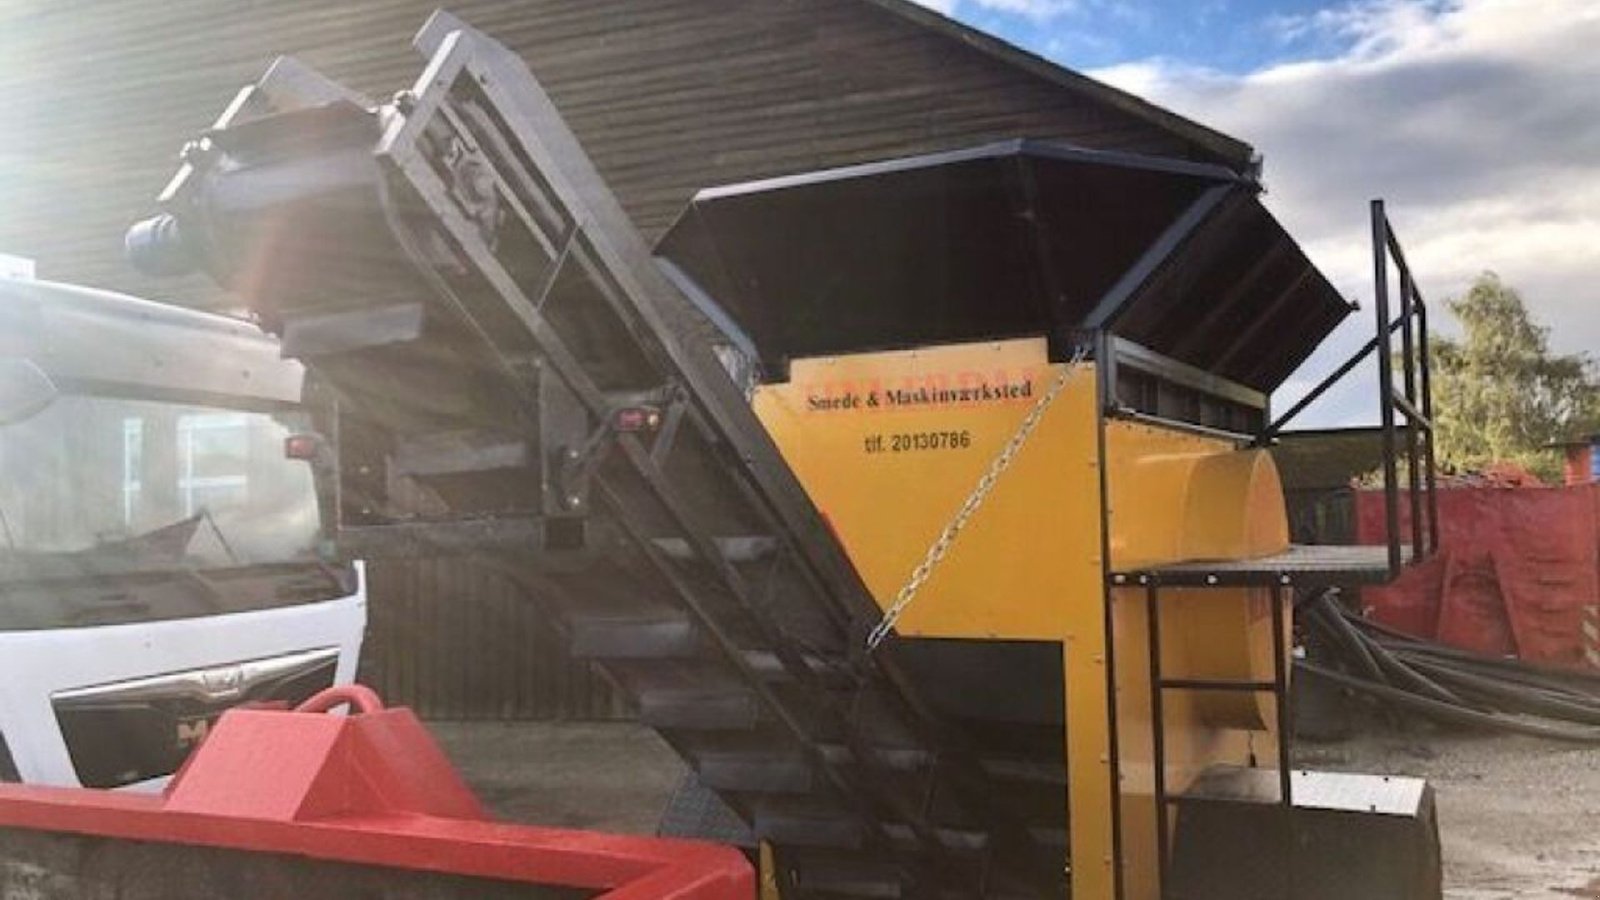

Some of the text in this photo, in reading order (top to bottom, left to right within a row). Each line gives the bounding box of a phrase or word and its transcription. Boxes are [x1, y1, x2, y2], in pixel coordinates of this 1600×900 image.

[807, 391, 860, 412] Smede
[866, 390, 879, 409] &
[886, 379, 1032, 405] Maskinværksted
[892, 430, 971, 452] 20130786
